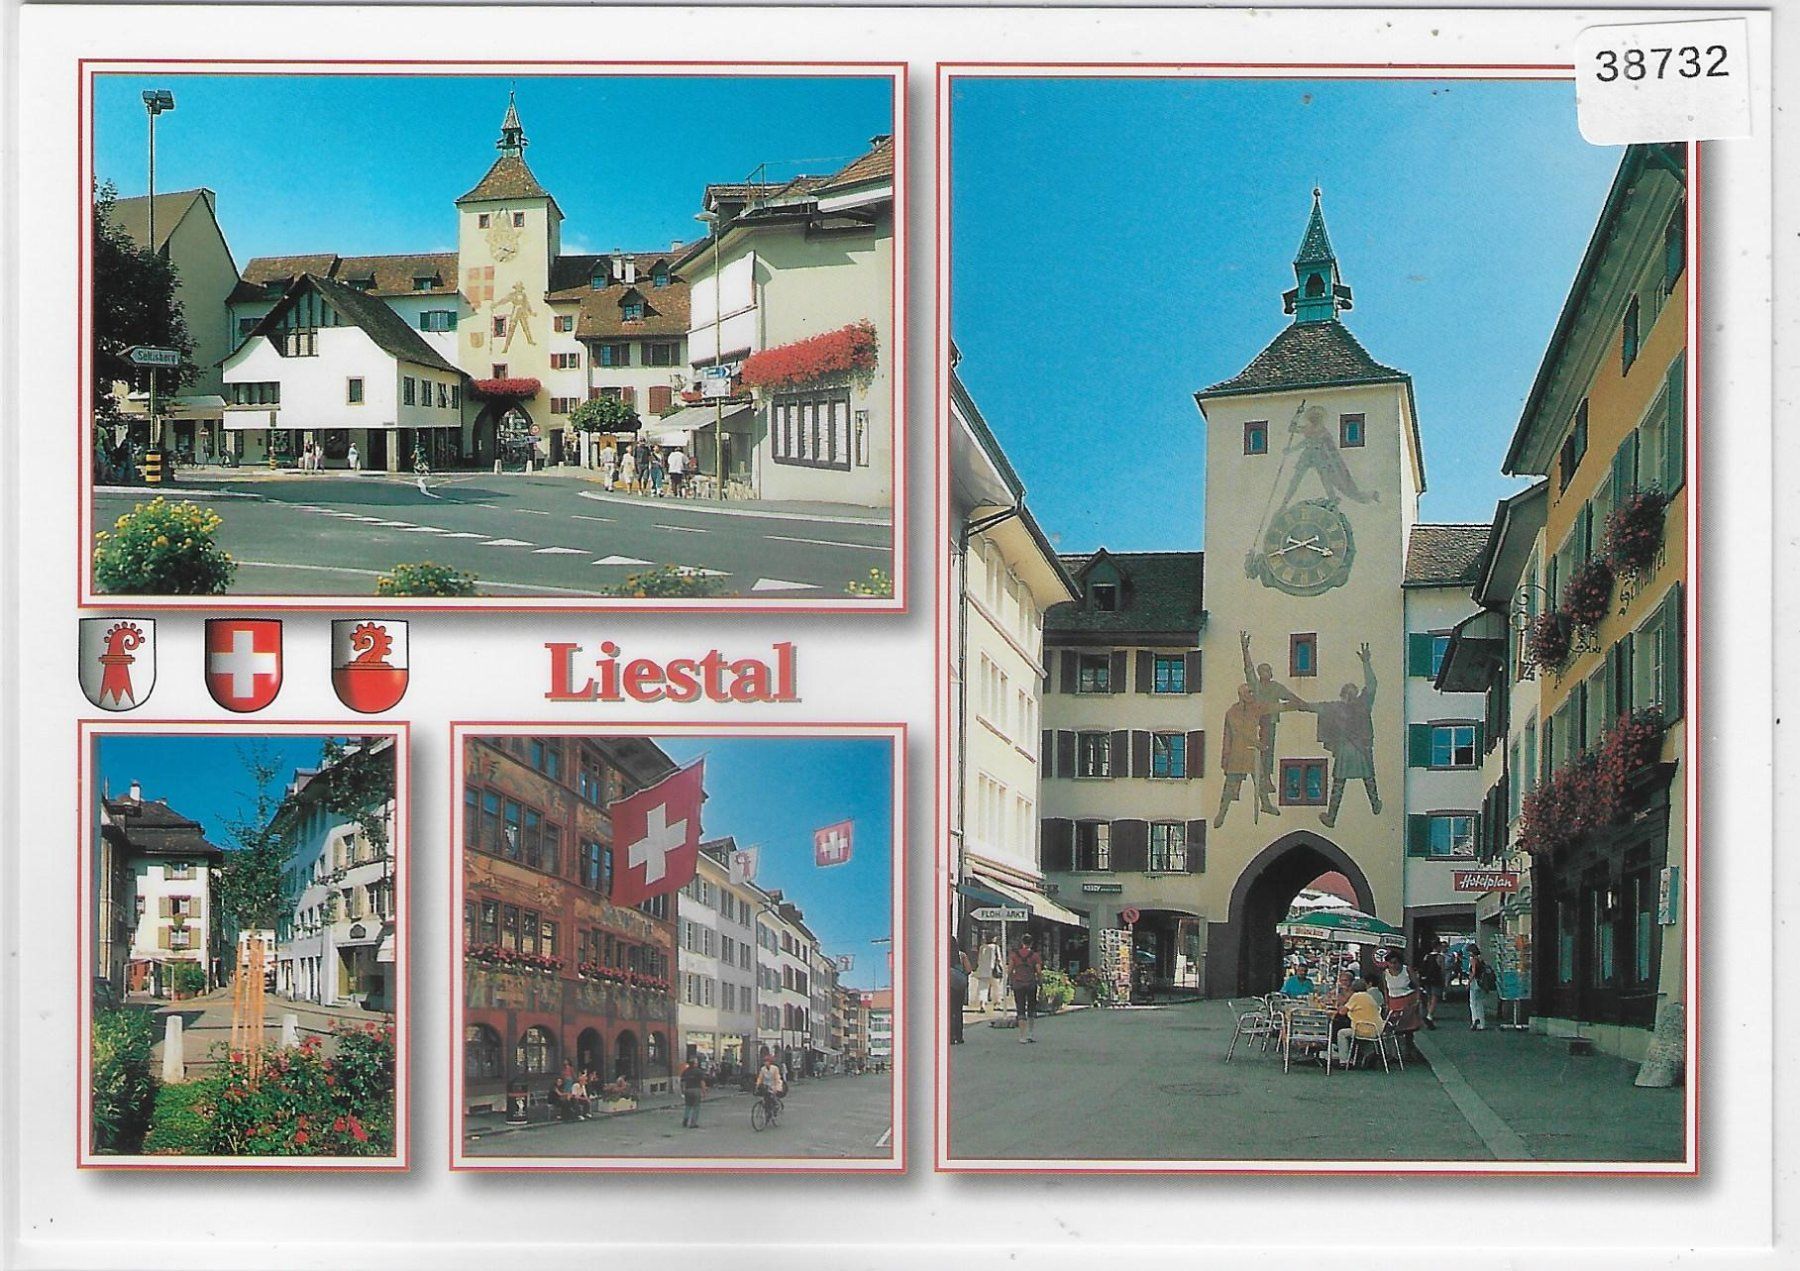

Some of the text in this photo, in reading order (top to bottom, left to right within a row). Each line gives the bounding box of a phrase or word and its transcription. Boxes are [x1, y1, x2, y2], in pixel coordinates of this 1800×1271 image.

[1595, 45, 1730, 82] 38732
[1459, 874, 1512, 890] Hotelplan
[980, 909, 1026, 919] FLOHARKT
